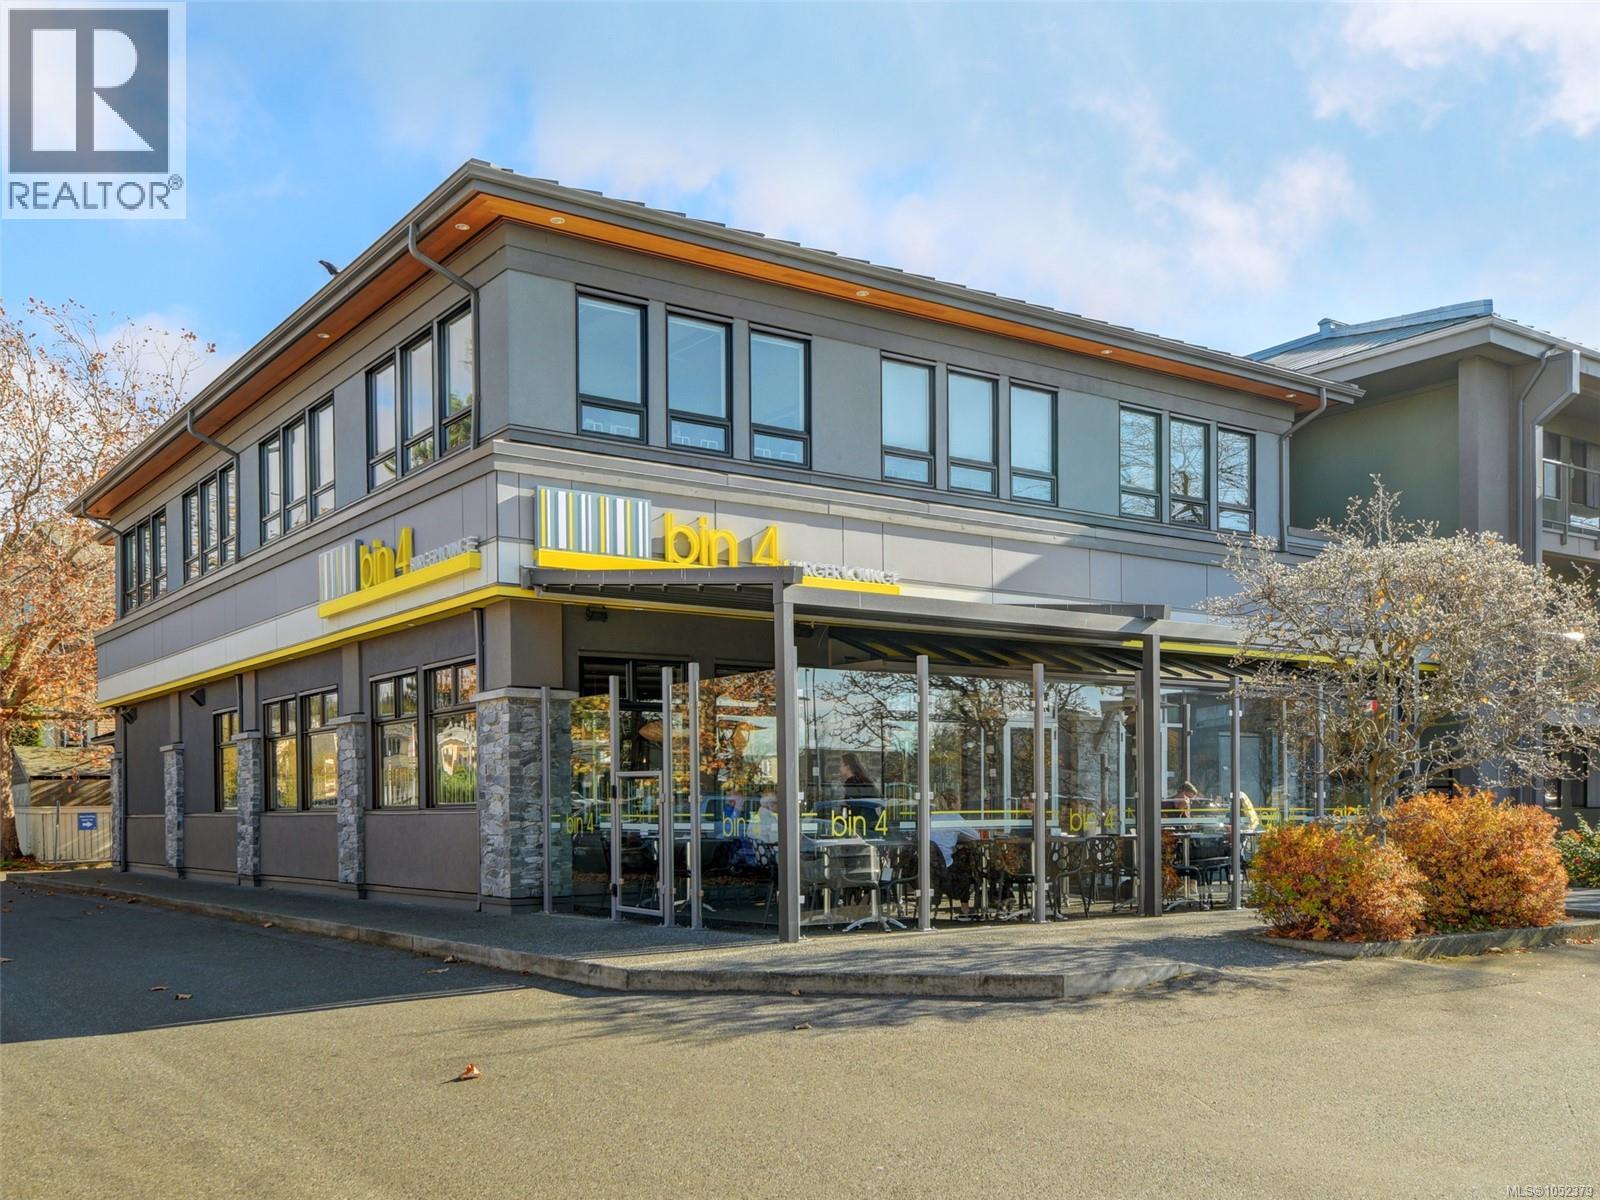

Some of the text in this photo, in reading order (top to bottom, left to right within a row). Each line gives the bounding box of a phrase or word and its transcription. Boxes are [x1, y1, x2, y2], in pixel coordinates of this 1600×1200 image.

[664, 512, 739, 567] bin
[752, 525, 780, 566] 4
[360, 538, 396, 590] bin
[396, 527, 414, 576] 4
[565, 811, 595, 834] bin 4
[722, 811, 746, 837] bin
[831, 810, 889, 838] bin 4
[1069, 808, 1116, 832] bin 4
